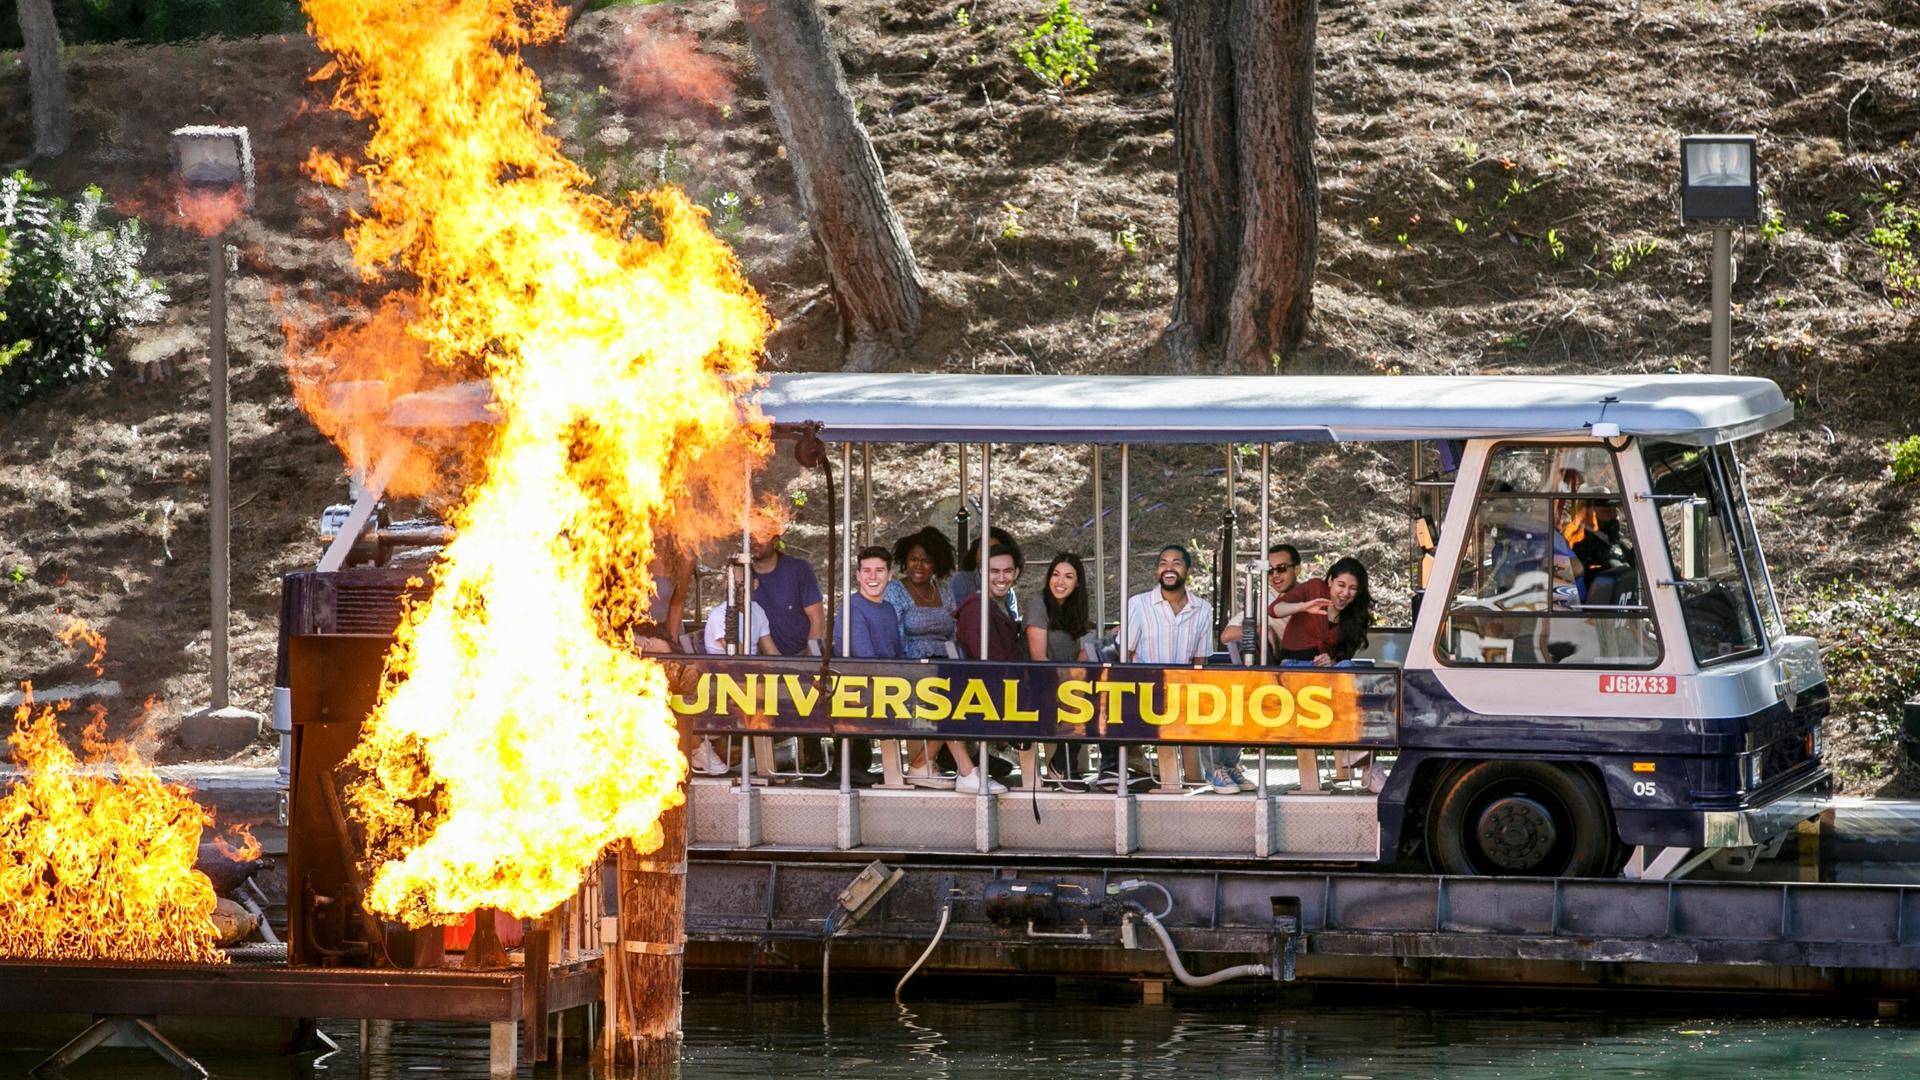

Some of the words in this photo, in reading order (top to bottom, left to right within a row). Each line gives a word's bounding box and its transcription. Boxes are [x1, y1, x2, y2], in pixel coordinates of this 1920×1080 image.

[1605, 676, 1668, 694] JG8X33
[671, 672, 1039, 723] UNIVERSAL
[1056, 680, 1334, 729] STUDIOS
[1633, 782, 1656, 796] 05
